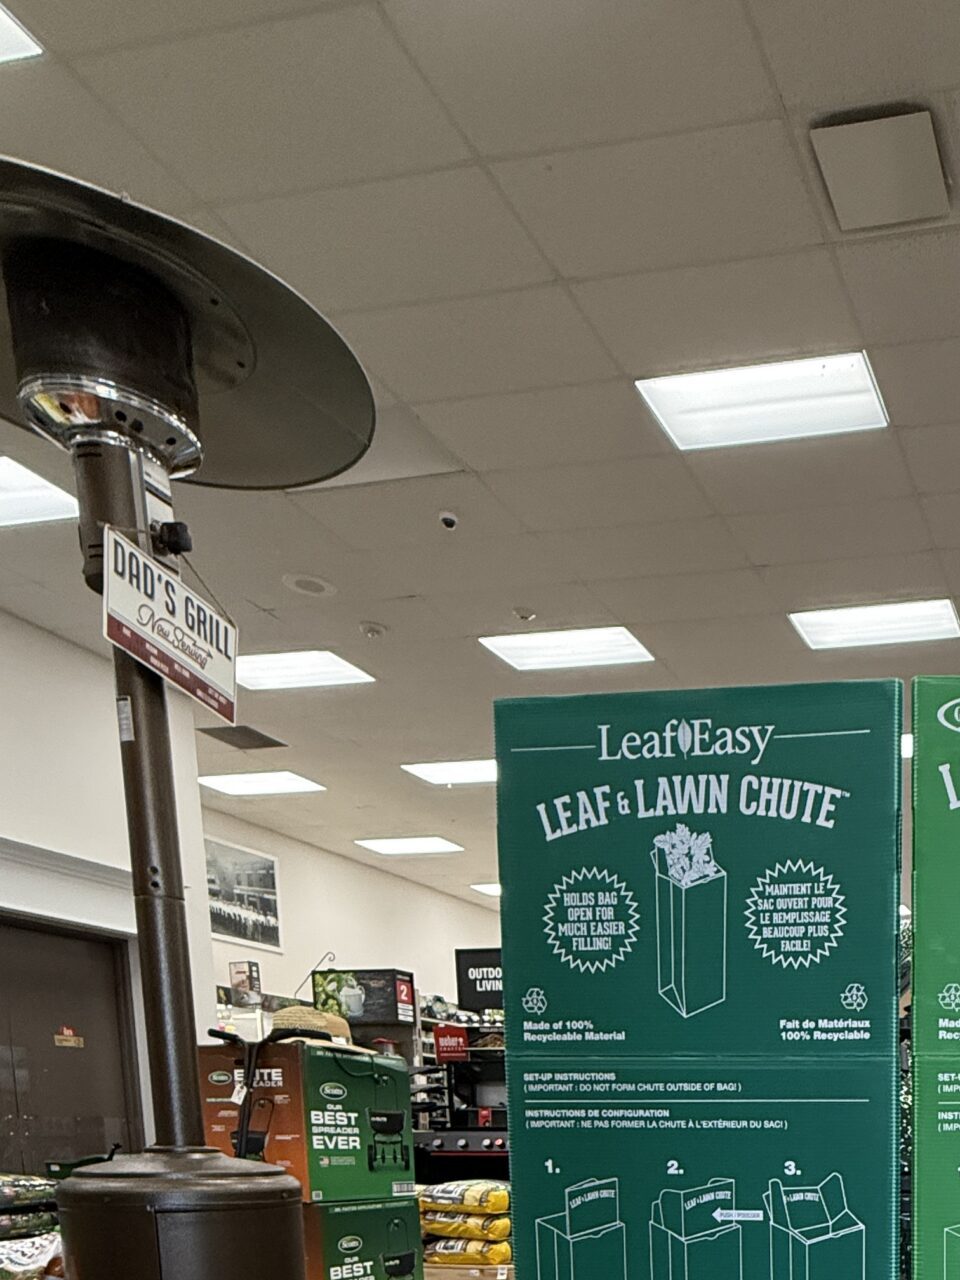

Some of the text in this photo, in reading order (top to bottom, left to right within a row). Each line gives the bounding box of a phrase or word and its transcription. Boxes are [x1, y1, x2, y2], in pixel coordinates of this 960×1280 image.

[113, 538, 176, 616] DAD'S
[184, 595, 233, 663] GRILL
[137, 603, 171, 640] Now
[171, 624, 209, 671] Serving
[536, 785, 611, 841] LEAF
[617, 791, 630, 815] &
[633, 774, 729, 818] LAWN
[764, 882, 824, 896] MAINTIENT LE
[563, 891, 617, 906] HOLDS BAG
[756, 895, 834, 910] SAC OUVERT POUR
[567, 906, 614, 921] OPEN FOR
[759, 910, 831, 924] LE REMPLISSAGE
[557, 921, 625, 936] MUCH EASIER
[762, 924, 829, 938] BEAUCOUP PLUS
[572, 936, 611, 950] FILLING!
[780, 939, 810, 952] FACILE!
[468, 967, 501, 979] OUTDO
[476, 980, 502, 991] LIVIN
[400, 985, 408, 1001] 2
[522, 1020, 594, 1030] Made of 100%
[779, 1019, 800, 1029] Fait
[801, 1018, 815, 1028] de
[584, 1030, 625, 1040] Material
[780, 1029, 870, 1041] 100% Recyclable
[233, 1068, 283, 1081] EITE
[523, 1072, 616, 1081] SET-UP INSTRUCTIONS
[310, 1110, 358, 1126] BEST
[312, 1126, 360, 1135] SPREADER
[312, 1135, 360, 1150] EVER
[544, 1159, 560, 1174] 1.
[667, 1160, 684, 1174] 2.
[784, 1160, 802, 1175] 3.
[329, 1261, 374, 1280] BEST
